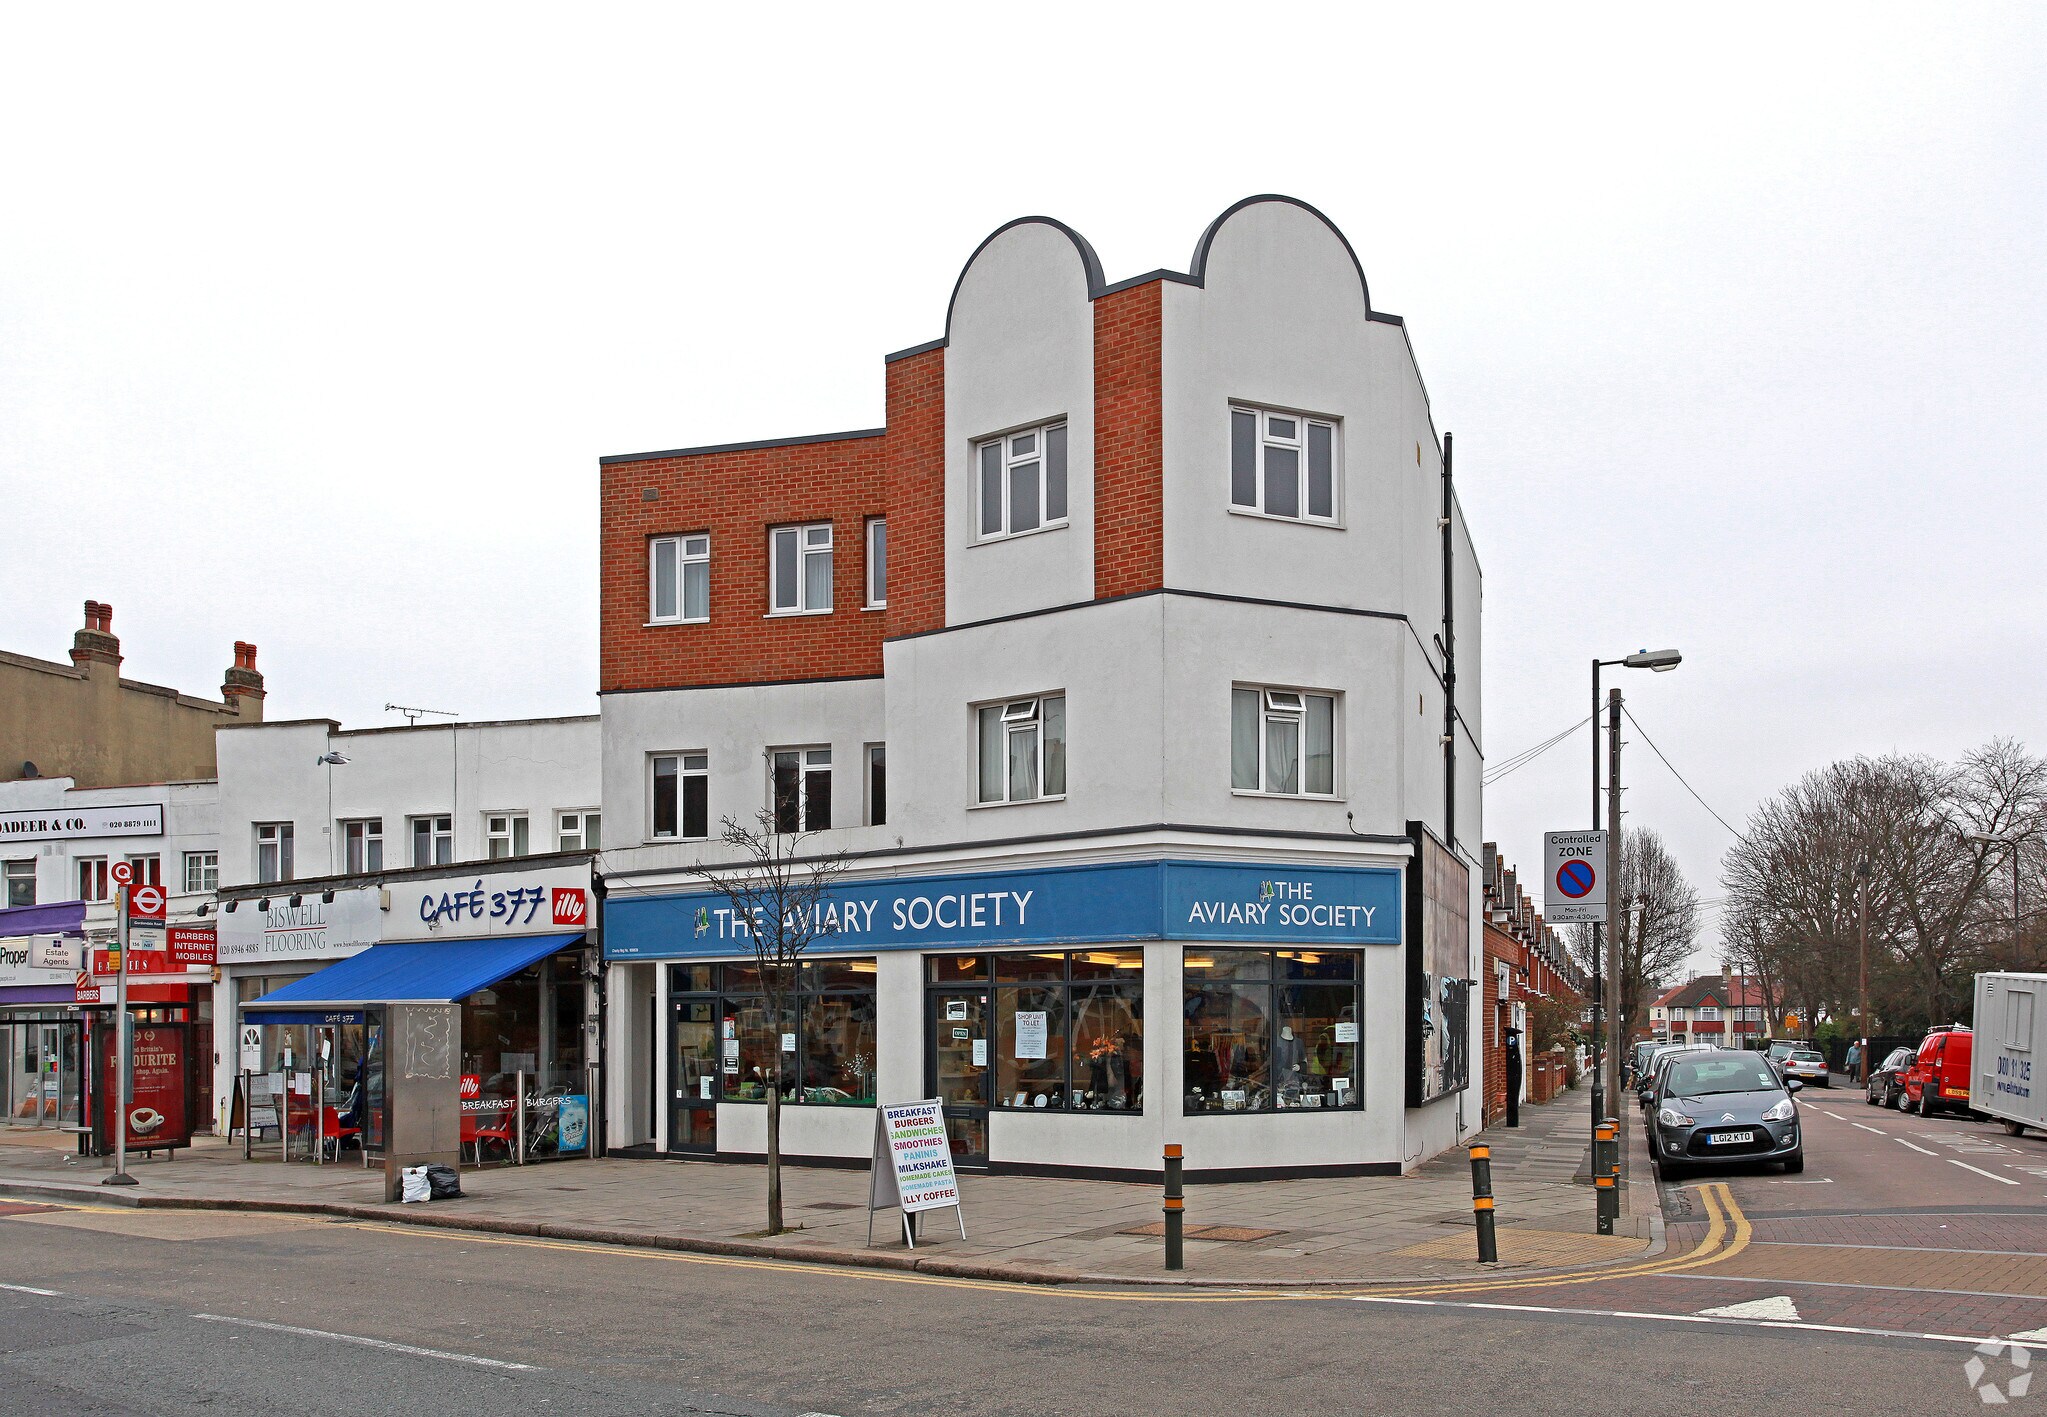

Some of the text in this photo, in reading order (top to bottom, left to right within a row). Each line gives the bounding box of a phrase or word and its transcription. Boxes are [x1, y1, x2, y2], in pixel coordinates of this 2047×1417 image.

[0, 817, 87, 834] ADEER & CO.
[123, 820, 141, 828] 8879
[1551, 834, 1601, 844] Controlled
[1559, 847, 1593, 857] ZONE
[1275, 881, 1313, 900] THE
[420, 879, 546, 925] CAFÉ 377
[554, 892, 585, 922] illy
[266, 903, 327, 928] BISWELL
[714, 891, 1033, 938] THE AVIARY SOCIETY
[1188, 902, 1376, 928] AVIARY SOCIETY
[175, 932, 215, 941] BARBERS
[265, 932, 326, 952] FLOORING
[174, 942, 215, 951] INTERNET
[219, 943, 259, 955] 020 8946 4885
[43, 958, 69, 966] Agents
[176, 953, 214, 961] MOBILES
[77, 990, 99, 1001] BARBERS
[342, 1015, 354, 1023] 377
[110, 1053, 176, 1068] FOURITE
[460, 1077, 480, 1097] illy
[461, 1099, 515, 1110] BREAKFAST
[526, 1096, 571, 1108] BURGERS
[887, 1106, 937, 1119] BREAKFAST
[894, 1116, 935, 1128] BURGERS
[891, 1126, 944, 1140] SANDWICHES
[1713, 1133, 1732, 1142] LG12
[894, 1137, 943, 1151] SMOOTHIES
[903, 1149, 938, 1161] PANINIS
[898, 1159, 948, 1173] MILKSHAKE
[932, 1169, 952, 1178] CAKES
[934, 1178, 953, 1187] PASTA
[923, 1189, 955, 1201] COFFEE
